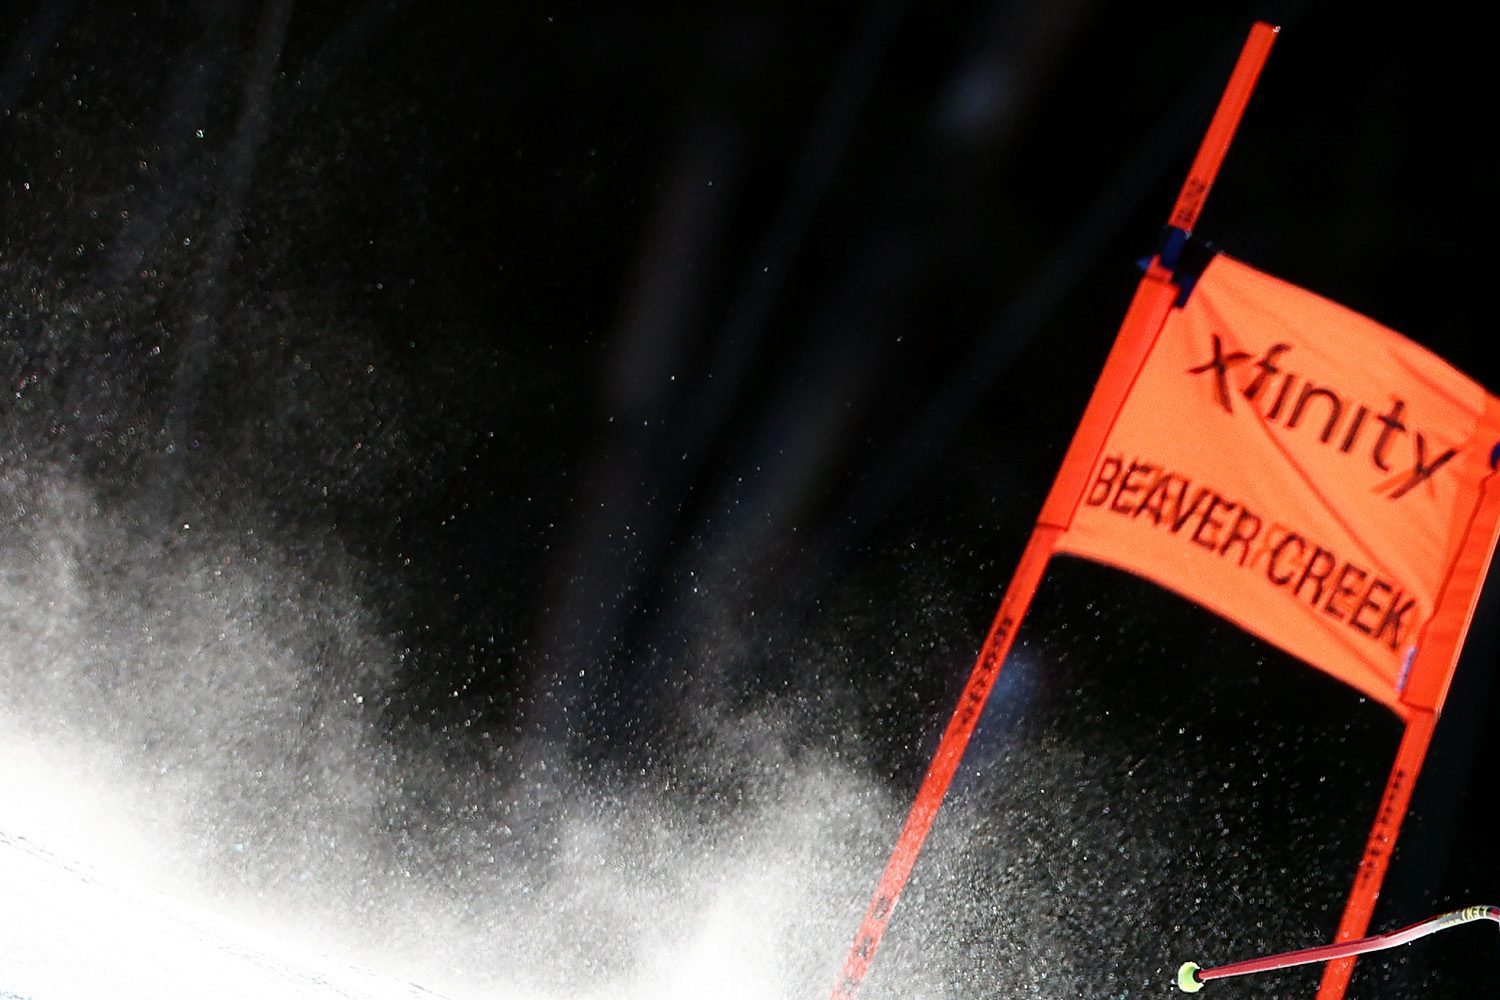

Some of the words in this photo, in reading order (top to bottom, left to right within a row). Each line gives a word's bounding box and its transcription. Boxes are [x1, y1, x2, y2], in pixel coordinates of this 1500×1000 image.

[1187, 333, 1459, 500] xfinity
[1086, 455, 1262, 568] BEAVER
[1267, 532, 1416, 651] CREEK
